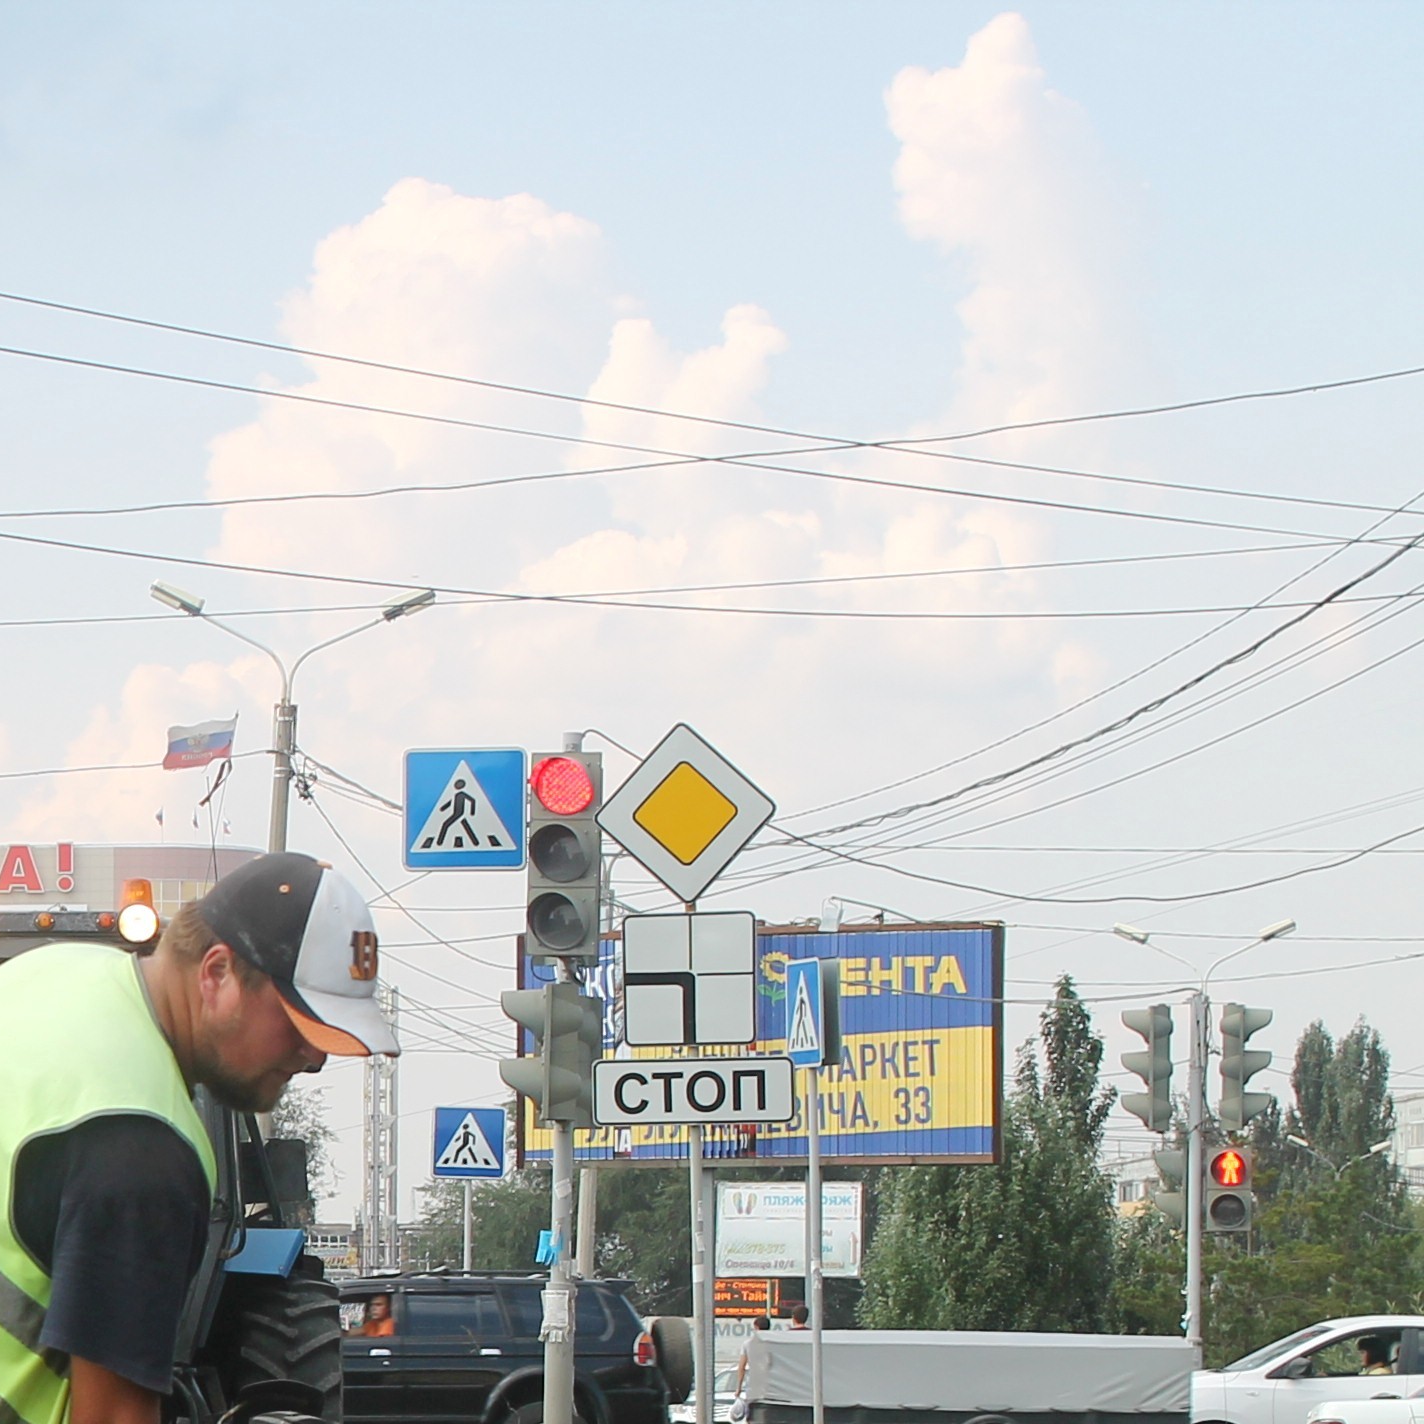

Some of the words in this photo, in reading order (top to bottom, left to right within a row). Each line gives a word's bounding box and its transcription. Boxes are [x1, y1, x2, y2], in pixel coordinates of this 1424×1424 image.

[839, 955, 967, 997] ЕНТА
[613, 1069, 767, 1115] СТОП
[893, 1086, 932, 1126] 33
